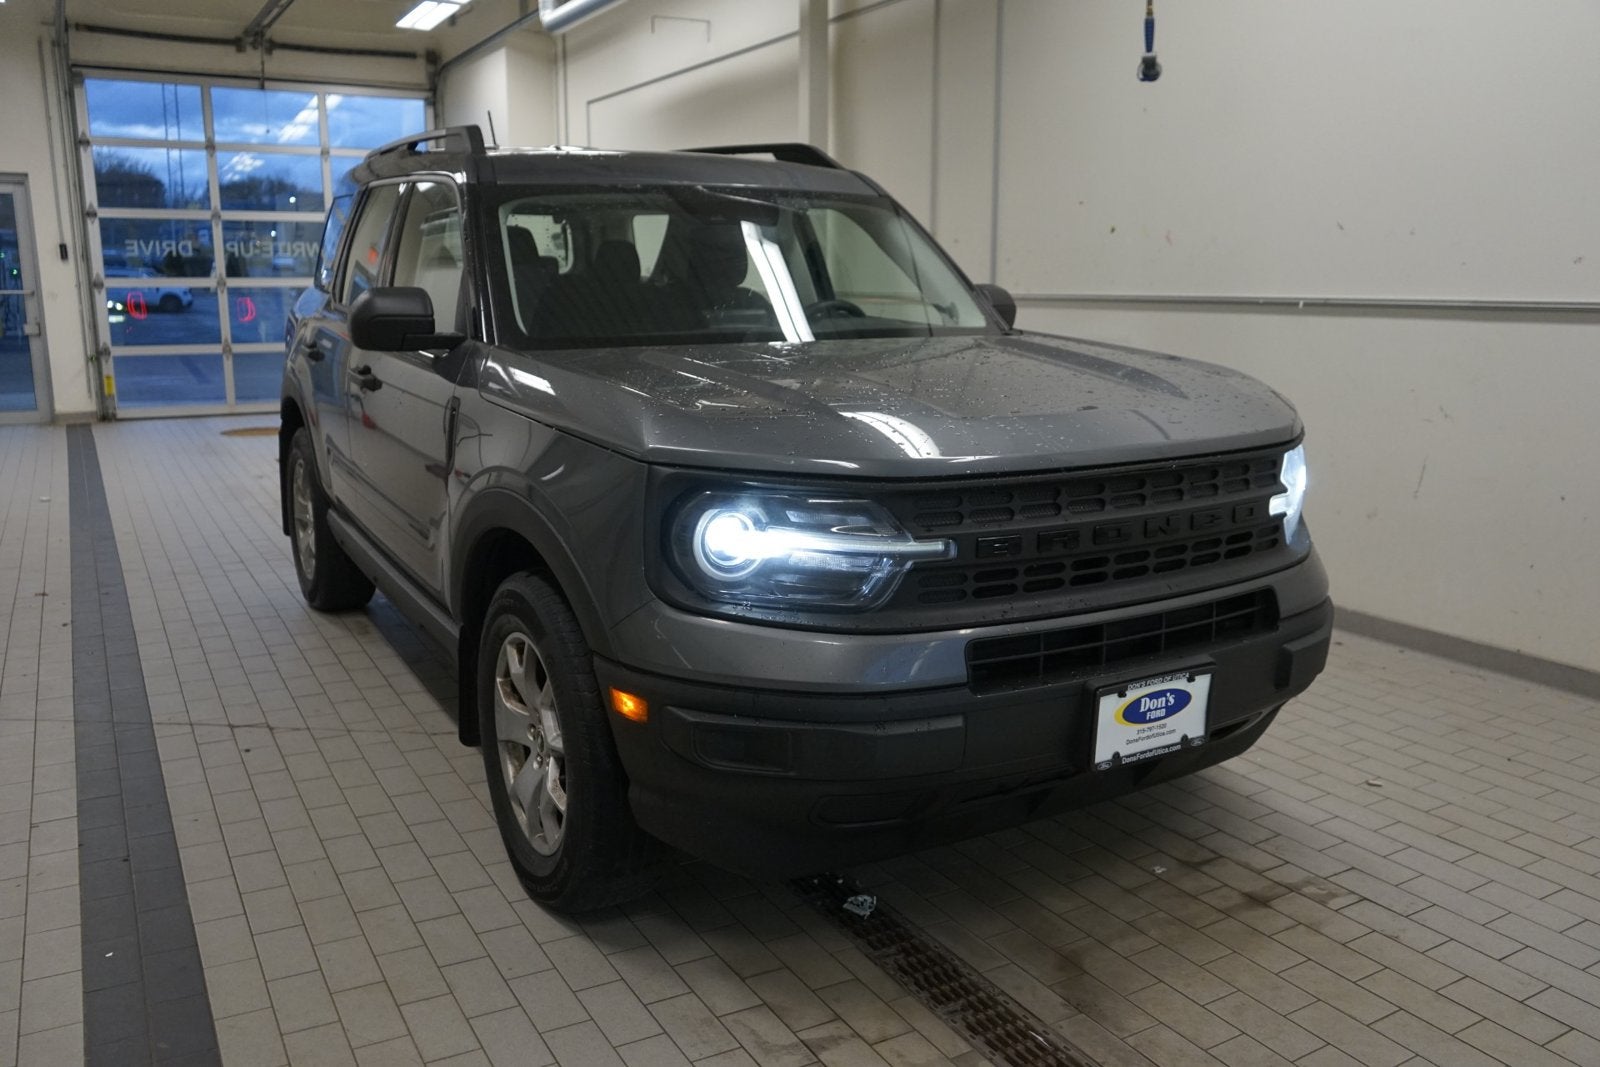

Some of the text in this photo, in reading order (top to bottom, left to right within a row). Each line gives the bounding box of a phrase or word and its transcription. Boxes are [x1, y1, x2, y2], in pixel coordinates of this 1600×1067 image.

[975, 501, 1257, 559] BRONCO
[1128, 672, 1189, 690] DON'S FORD OF UTICA
[1139, 692, 1175, 713] Don's
[1146, 708, 1166, 720] FORD
[1126, 729, 1176, 745] DonsFordofUtica.com
[1122, 744, 1181, 764] DonsFordofUtica.com
